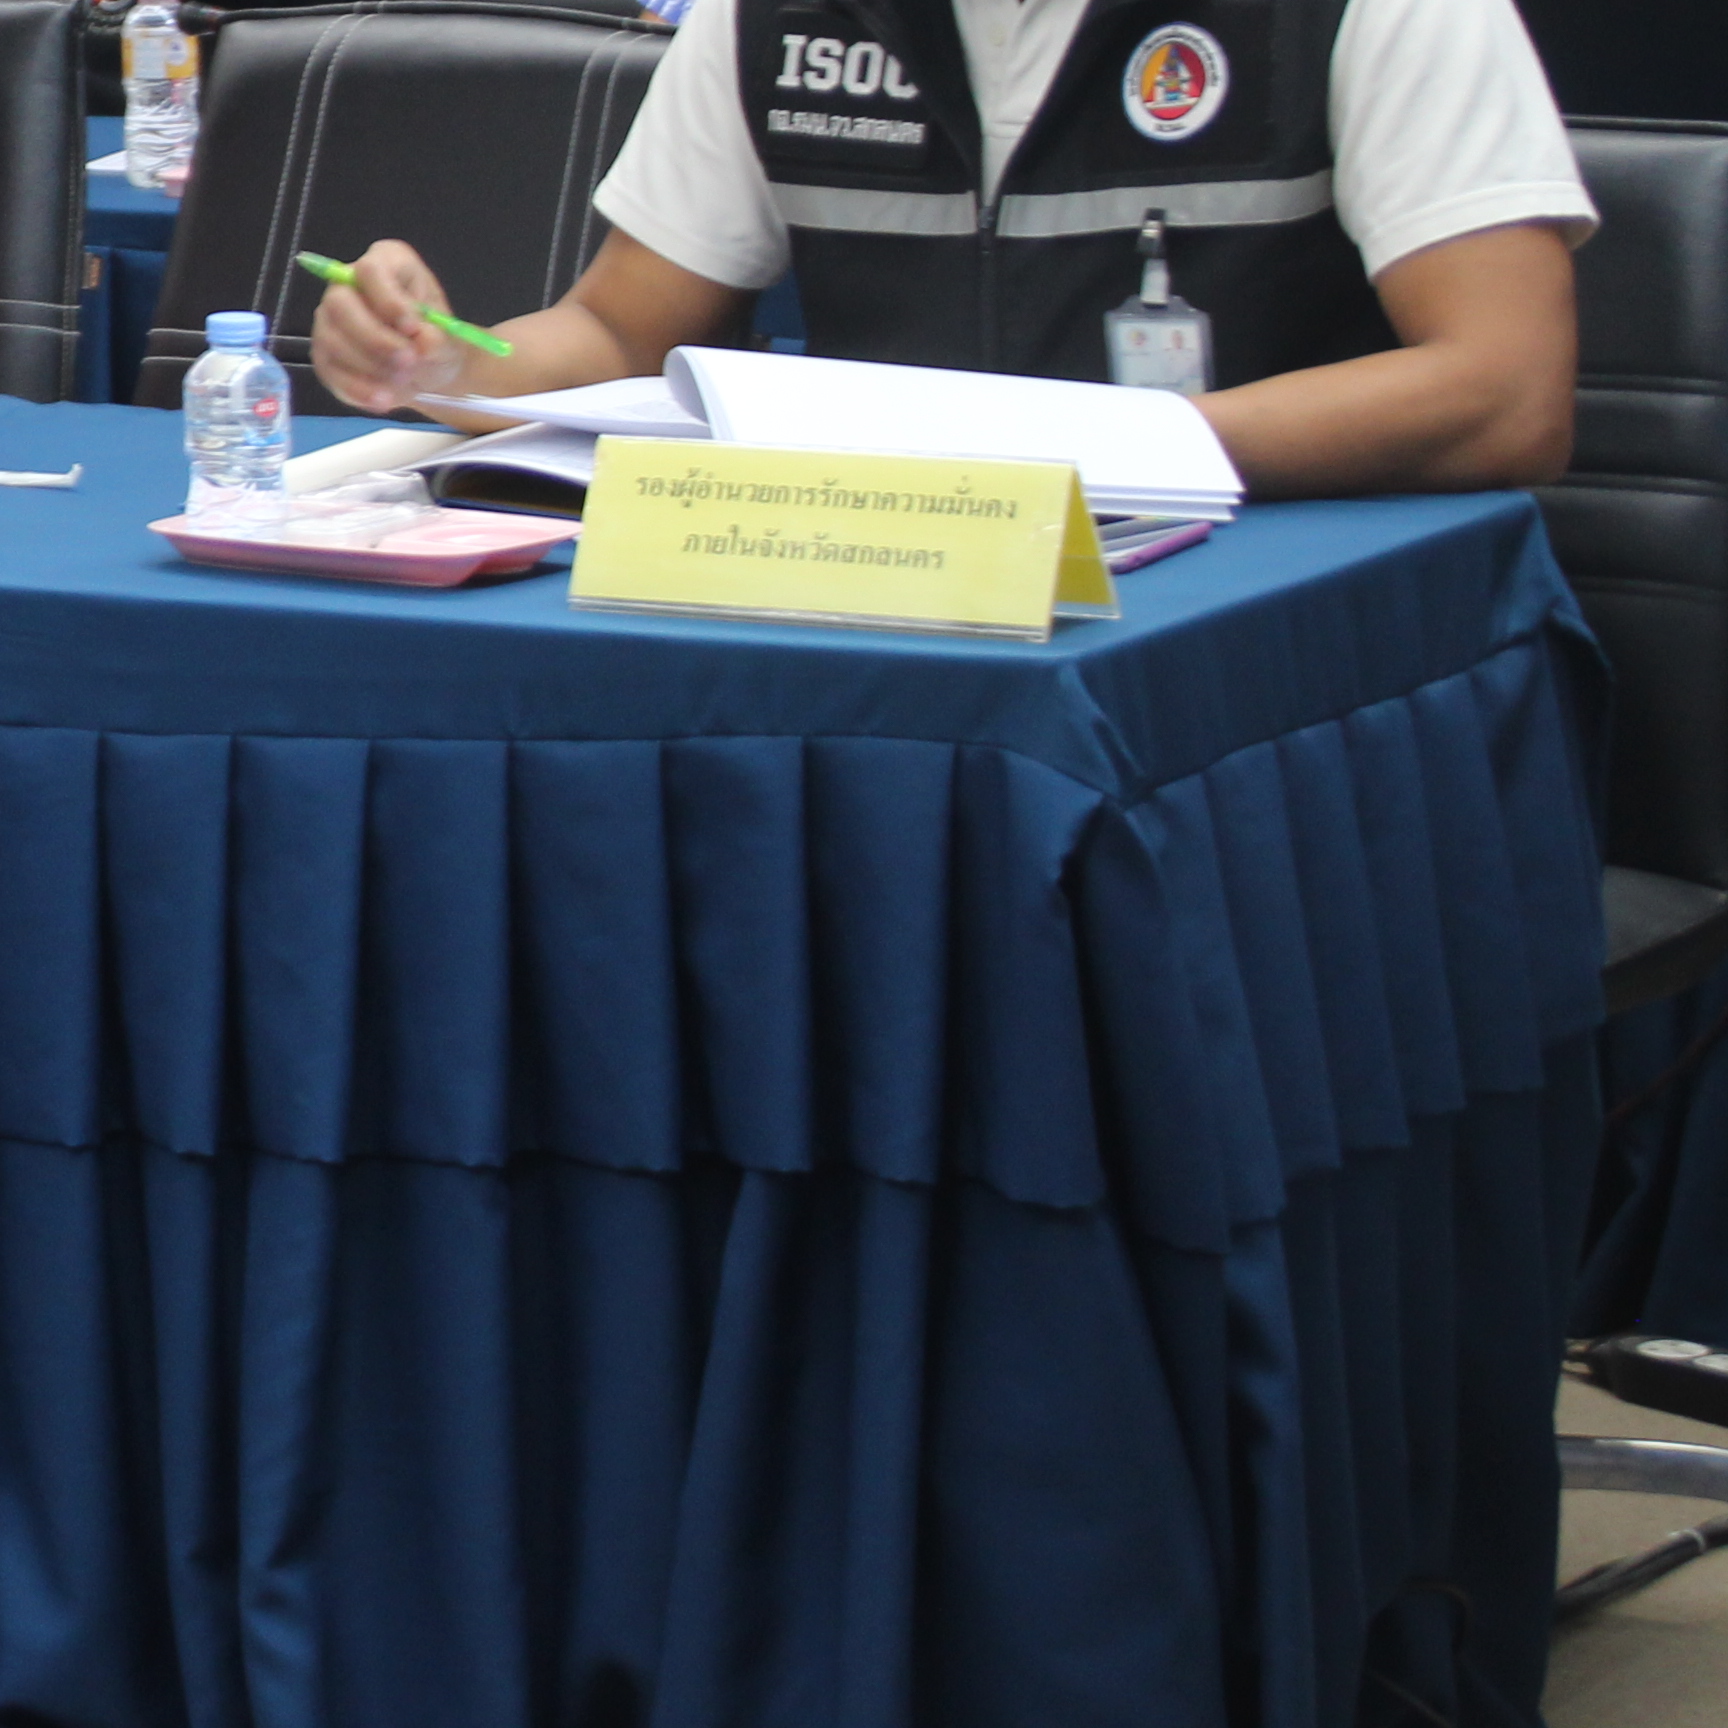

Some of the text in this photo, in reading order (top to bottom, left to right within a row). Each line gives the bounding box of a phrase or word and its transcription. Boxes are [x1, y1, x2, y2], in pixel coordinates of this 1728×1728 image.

[635, 466, 1018, 520] รองผู้อำนวยการรักษาความมั่นคง
[681, 524, 945, 570] ภายในจังหวัดสกลนคร
